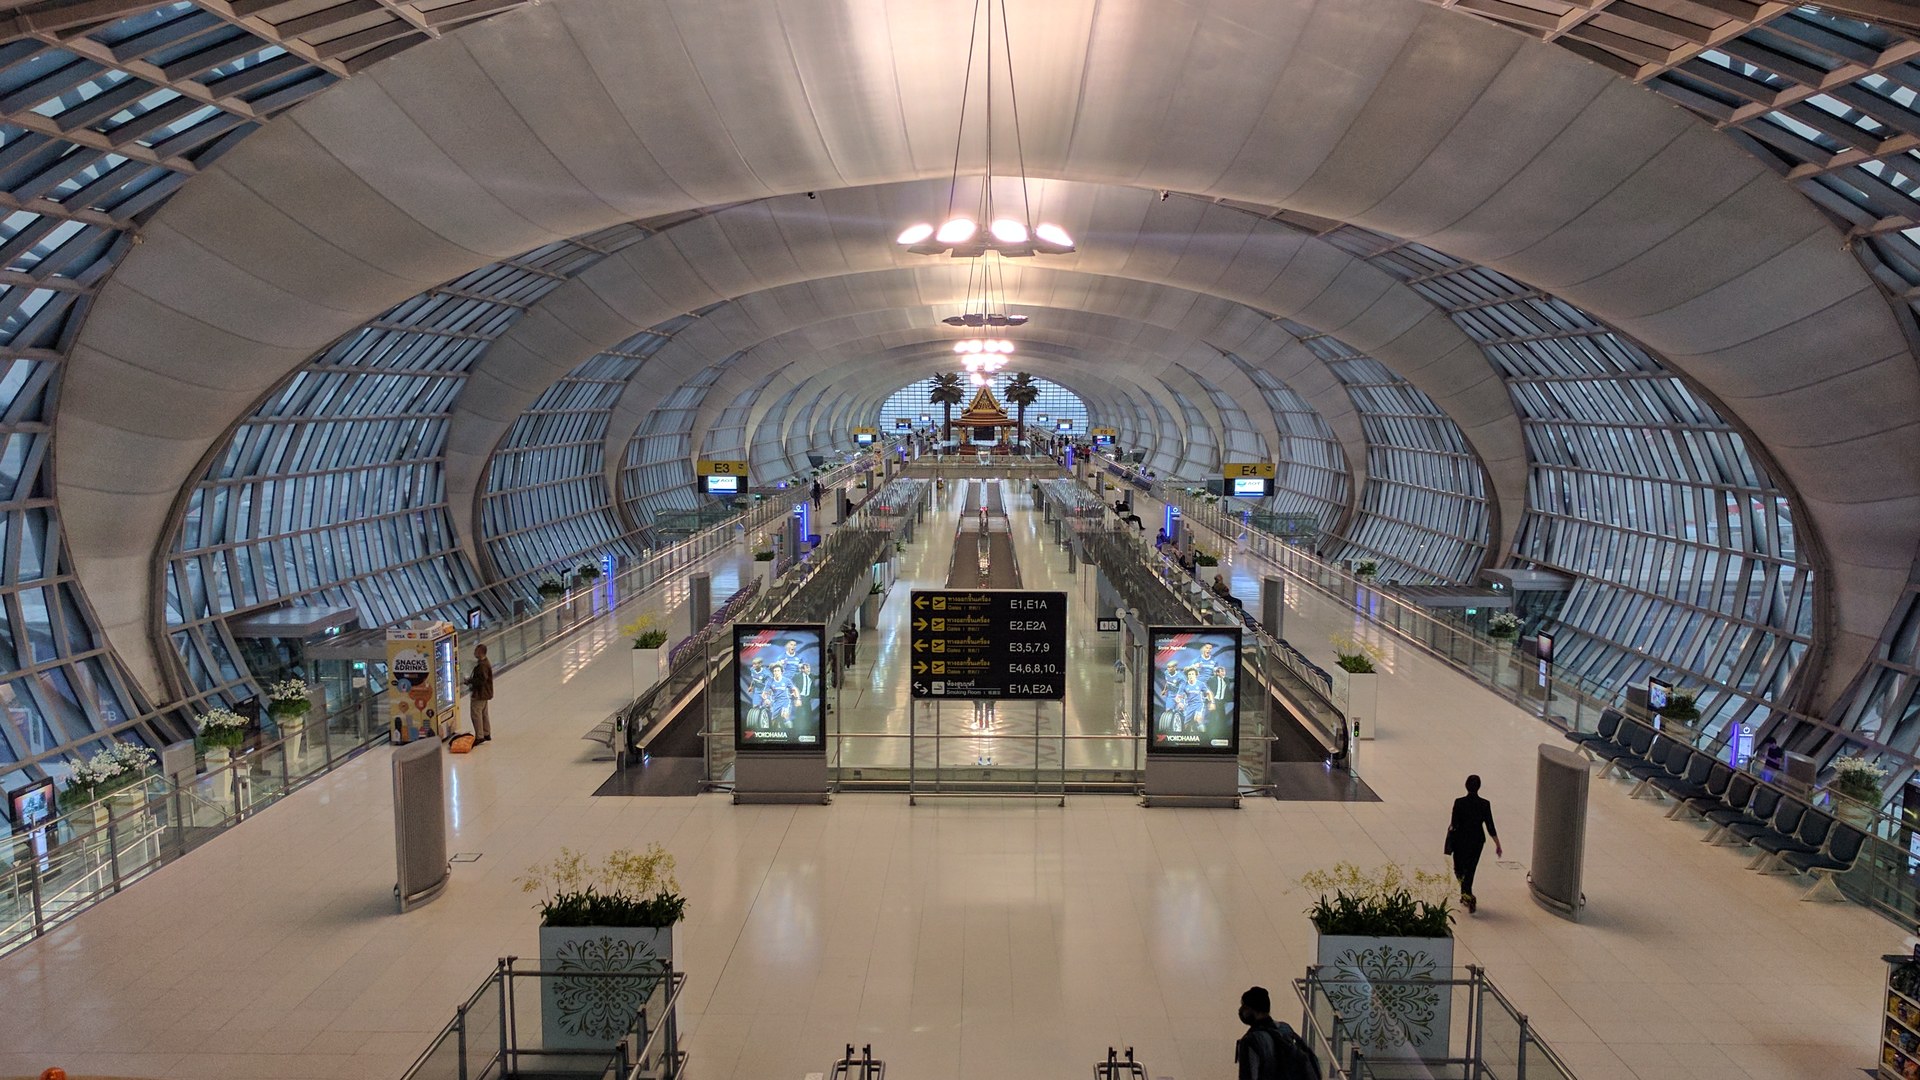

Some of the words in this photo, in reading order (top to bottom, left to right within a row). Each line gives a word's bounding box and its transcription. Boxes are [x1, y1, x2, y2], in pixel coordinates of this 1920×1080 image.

[714, 463, 730, 473] E3
[1241, 465, 1257, 476] E4
[1010, 599, 1048, 610] E1,E1A
[1009, 621, 1047, 631] E2,E2A
[1009, 642, 1050, 653] E3,5,7,9
[1009, 684, 1053, 695] E1A,E2A
